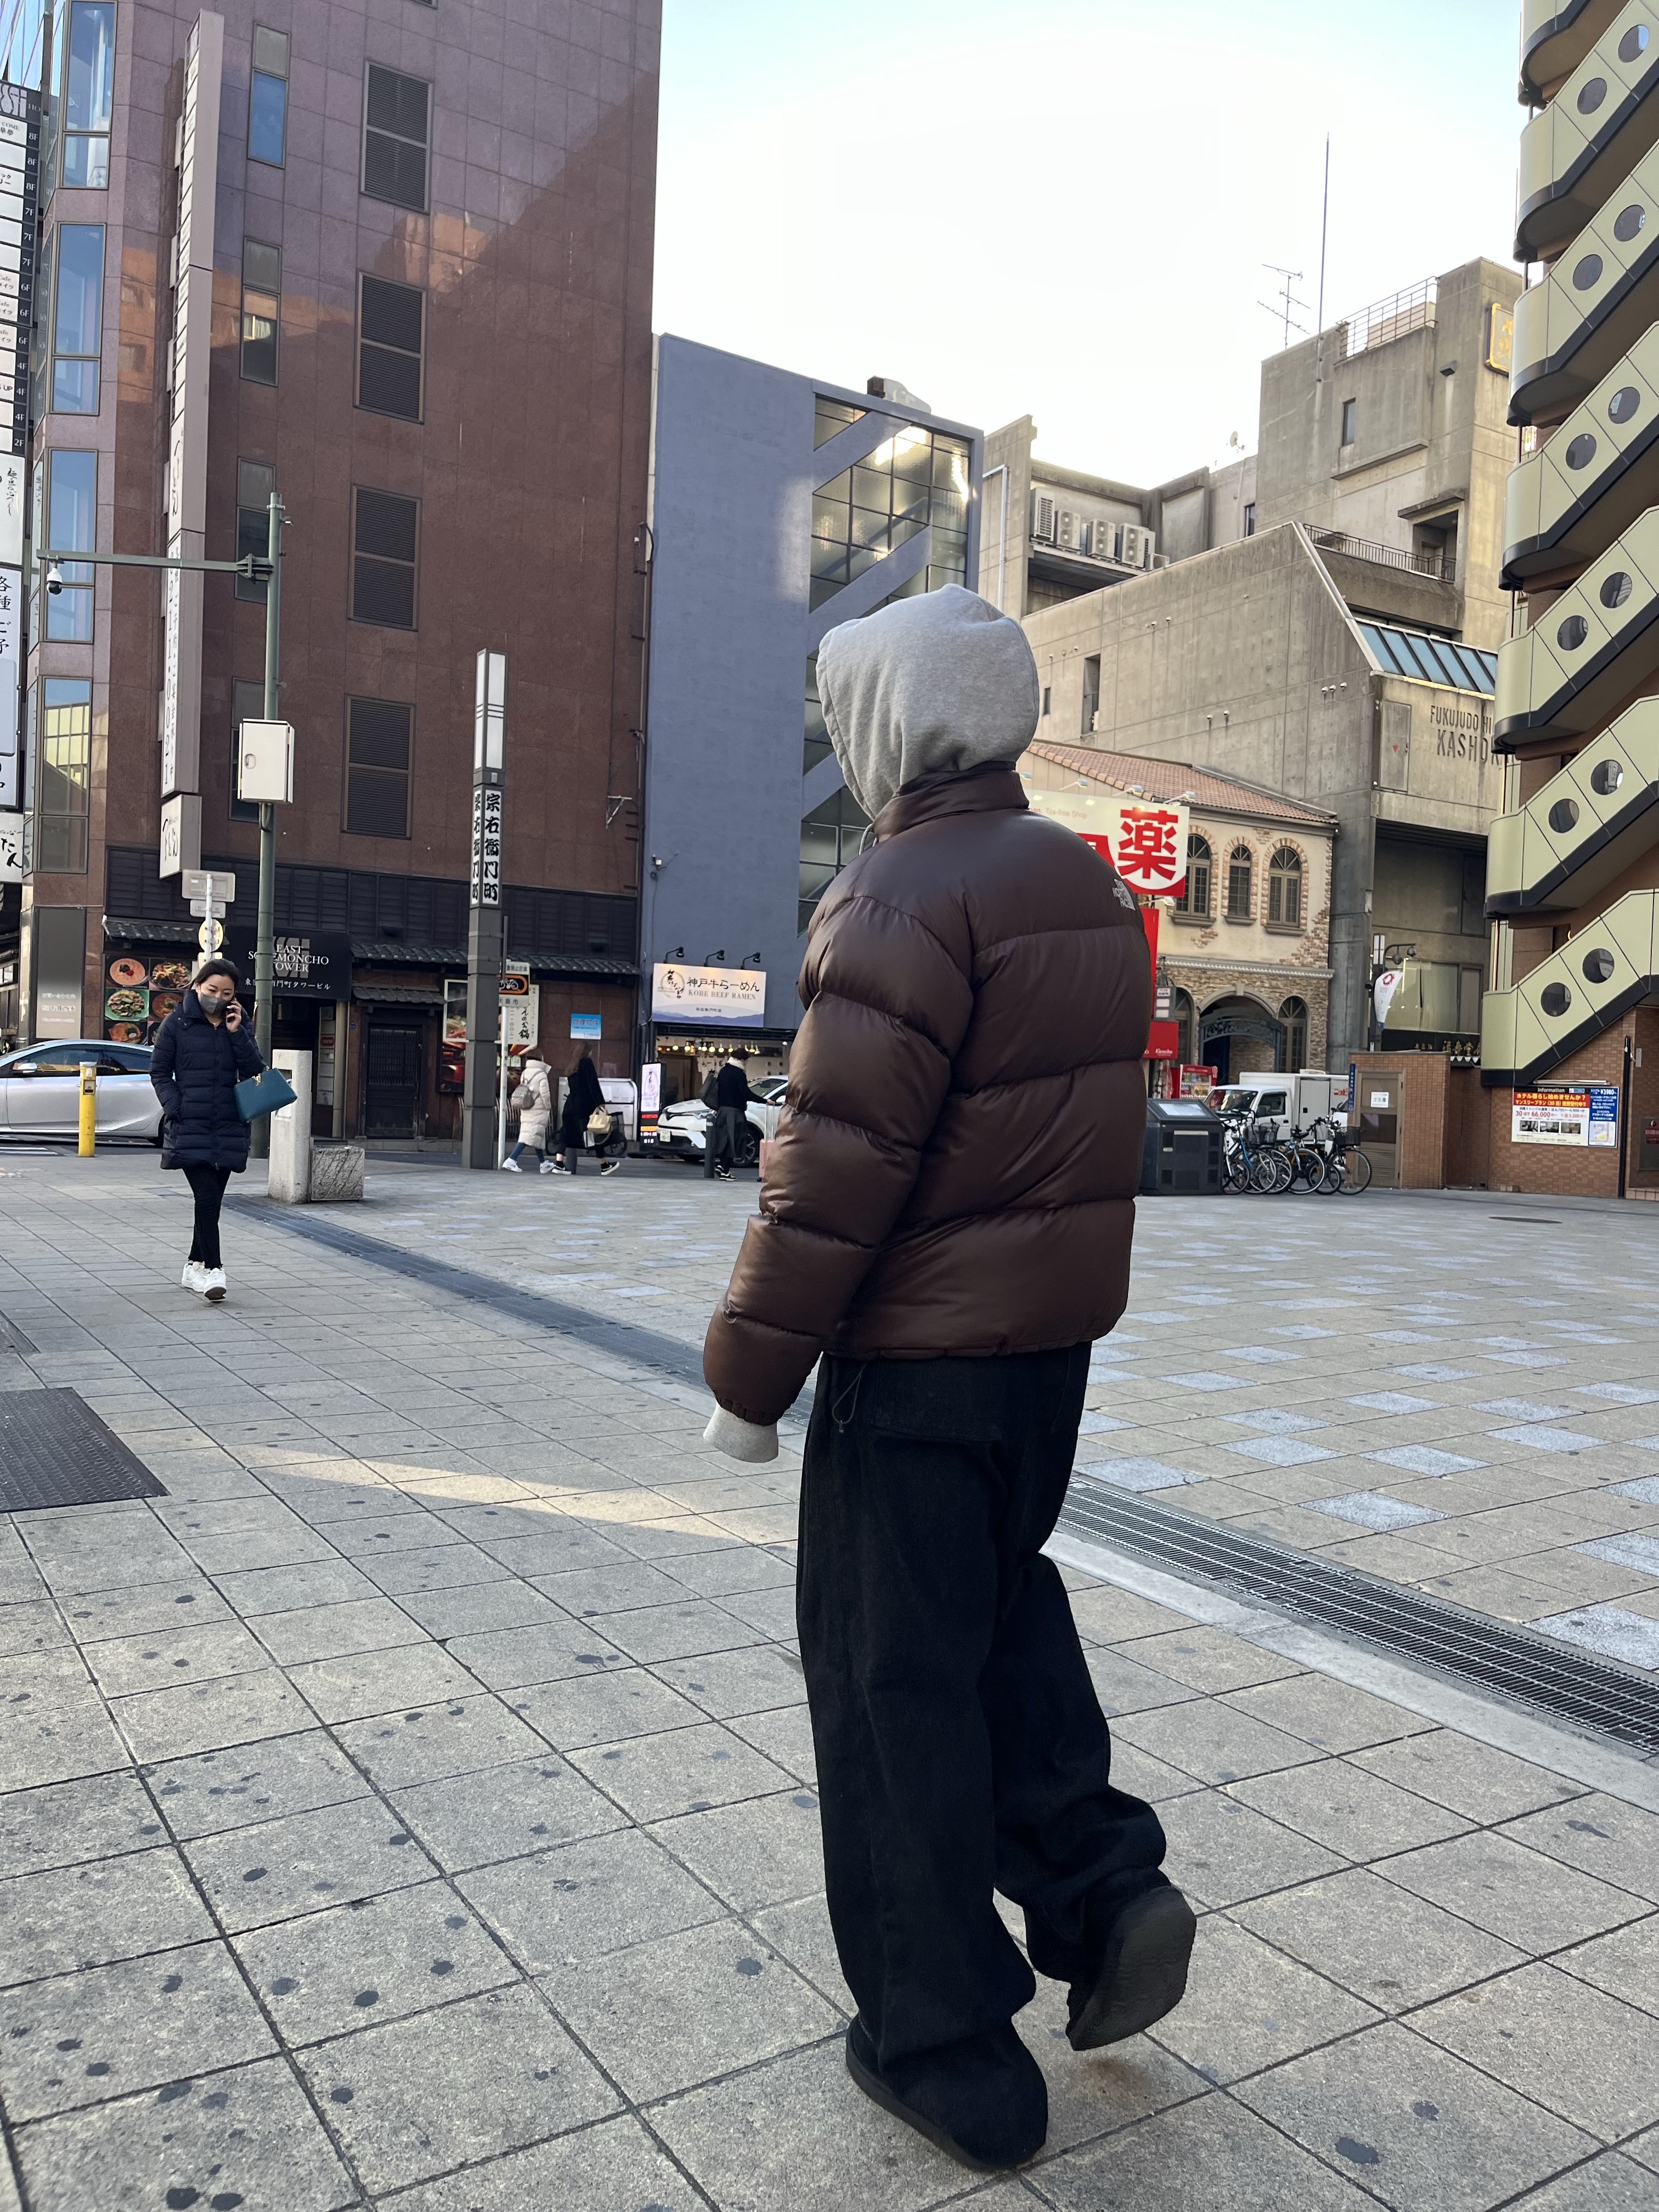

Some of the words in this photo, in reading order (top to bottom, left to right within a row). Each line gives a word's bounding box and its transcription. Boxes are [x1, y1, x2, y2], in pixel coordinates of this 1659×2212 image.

[29, 132, 38, 140] 8F
[27, 157, 37, 166] 8F
[26, 183, 36, 191] 8F
[25, 207, 35, 216] 7F
[24, 233, 33, 241] 7F
[22, 258, 32, 267] 7F
[21, 284, 31, 292] 6F
[20, 309, 30, 318] 6F
[19, 336, 29, 345] 6F
[16, 388, 26, 396] 4F
[15, 413, 25, 421] 4F
[14, 439, 25, 447] 2F
[1430, 705, 1479, 731] FUKUJUDO
[1045, 808, 1070, 816] Tax-free
[1071, 810, 1087, 819] Shop
[485, 793, 500, 901] 宗右衛門町
[1118, 807, 1178, 881] 薬
[276, 944, 303, 954] EAST
[687, 977, 759, 991] 神戸牛らーめん
[689, 989, 709, 997] KOBE
